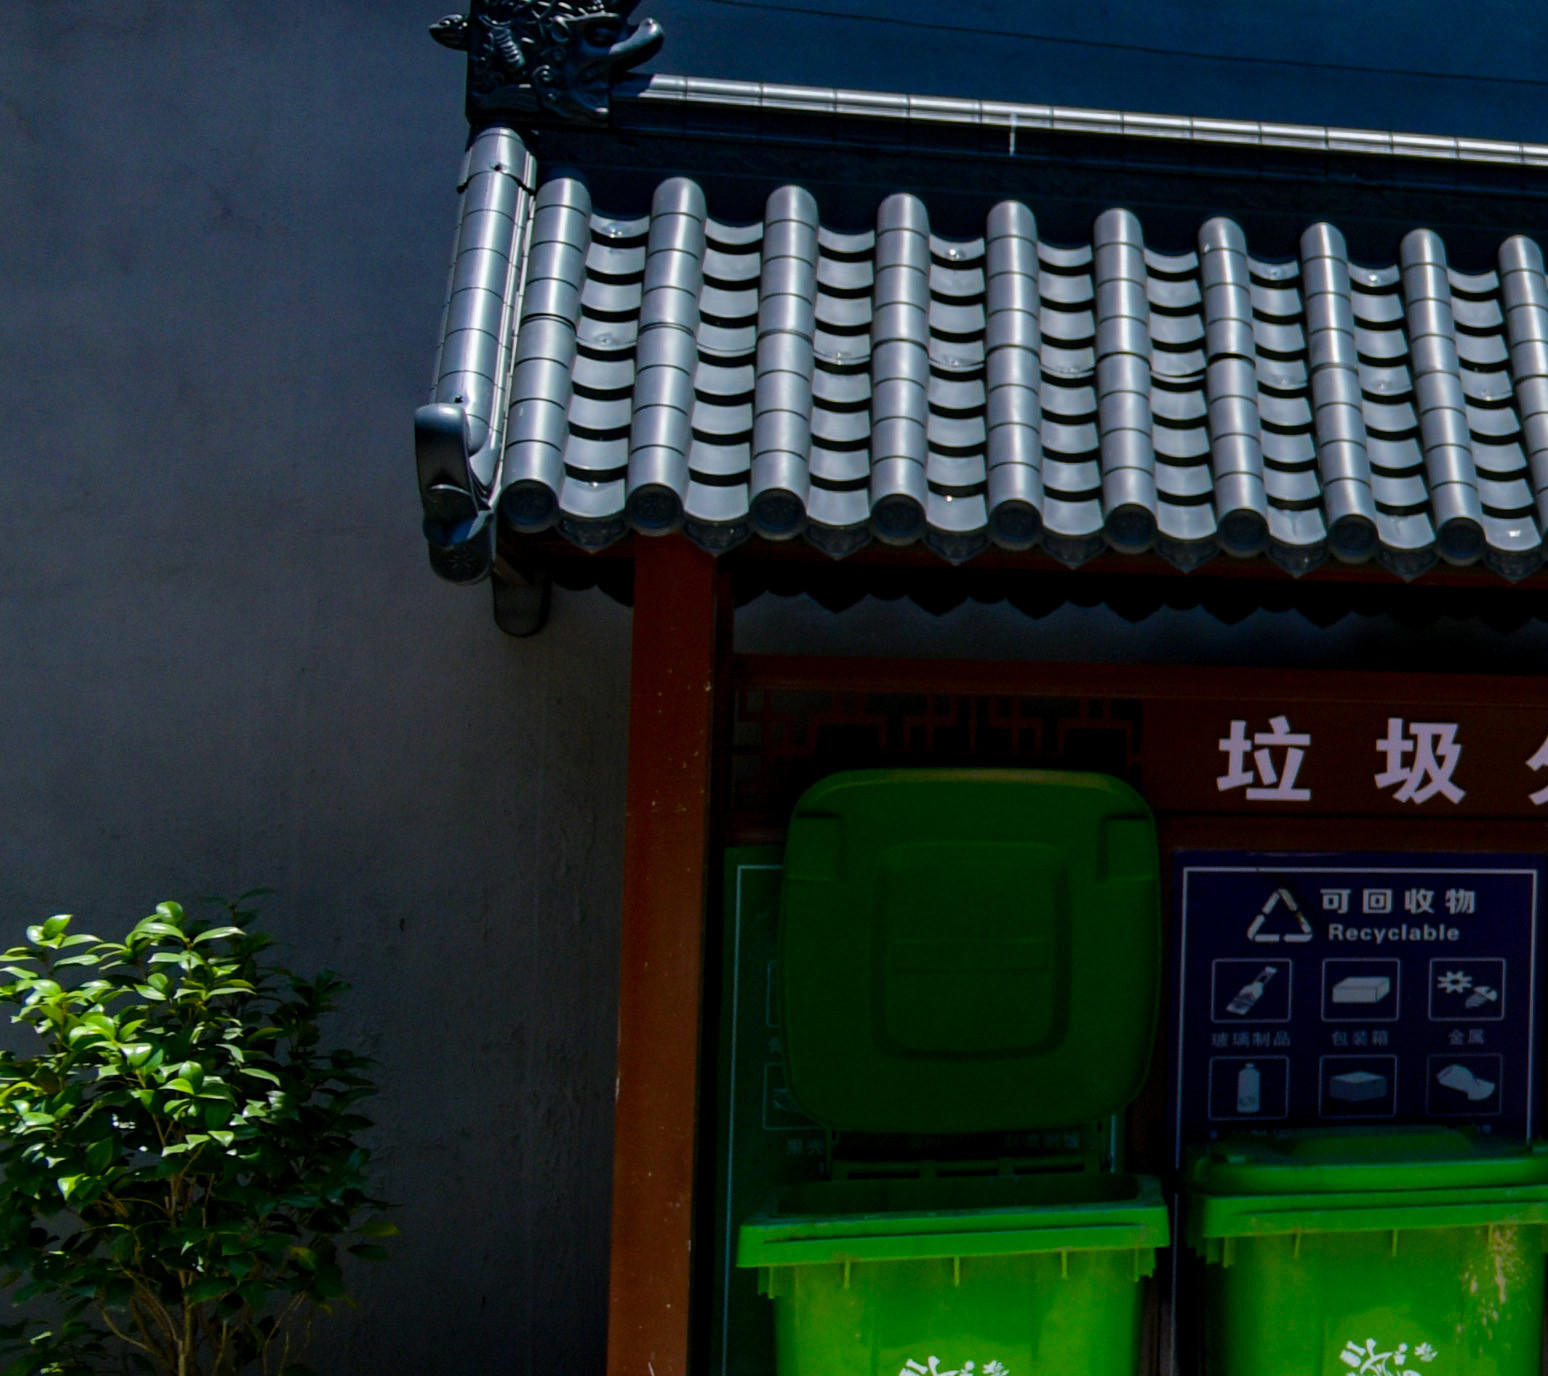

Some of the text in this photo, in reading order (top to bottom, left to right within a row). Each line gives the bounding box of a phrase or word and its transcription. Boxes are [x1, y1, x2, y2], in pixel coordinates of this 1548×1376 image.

[1319, 887, 1477, 916] 可回收物
[1327, 923, 1461, 944] Recyclable
[1330, 1029, 1390, 1047] 包装箱
[1447, 1027, 1486, 1046] 金属
